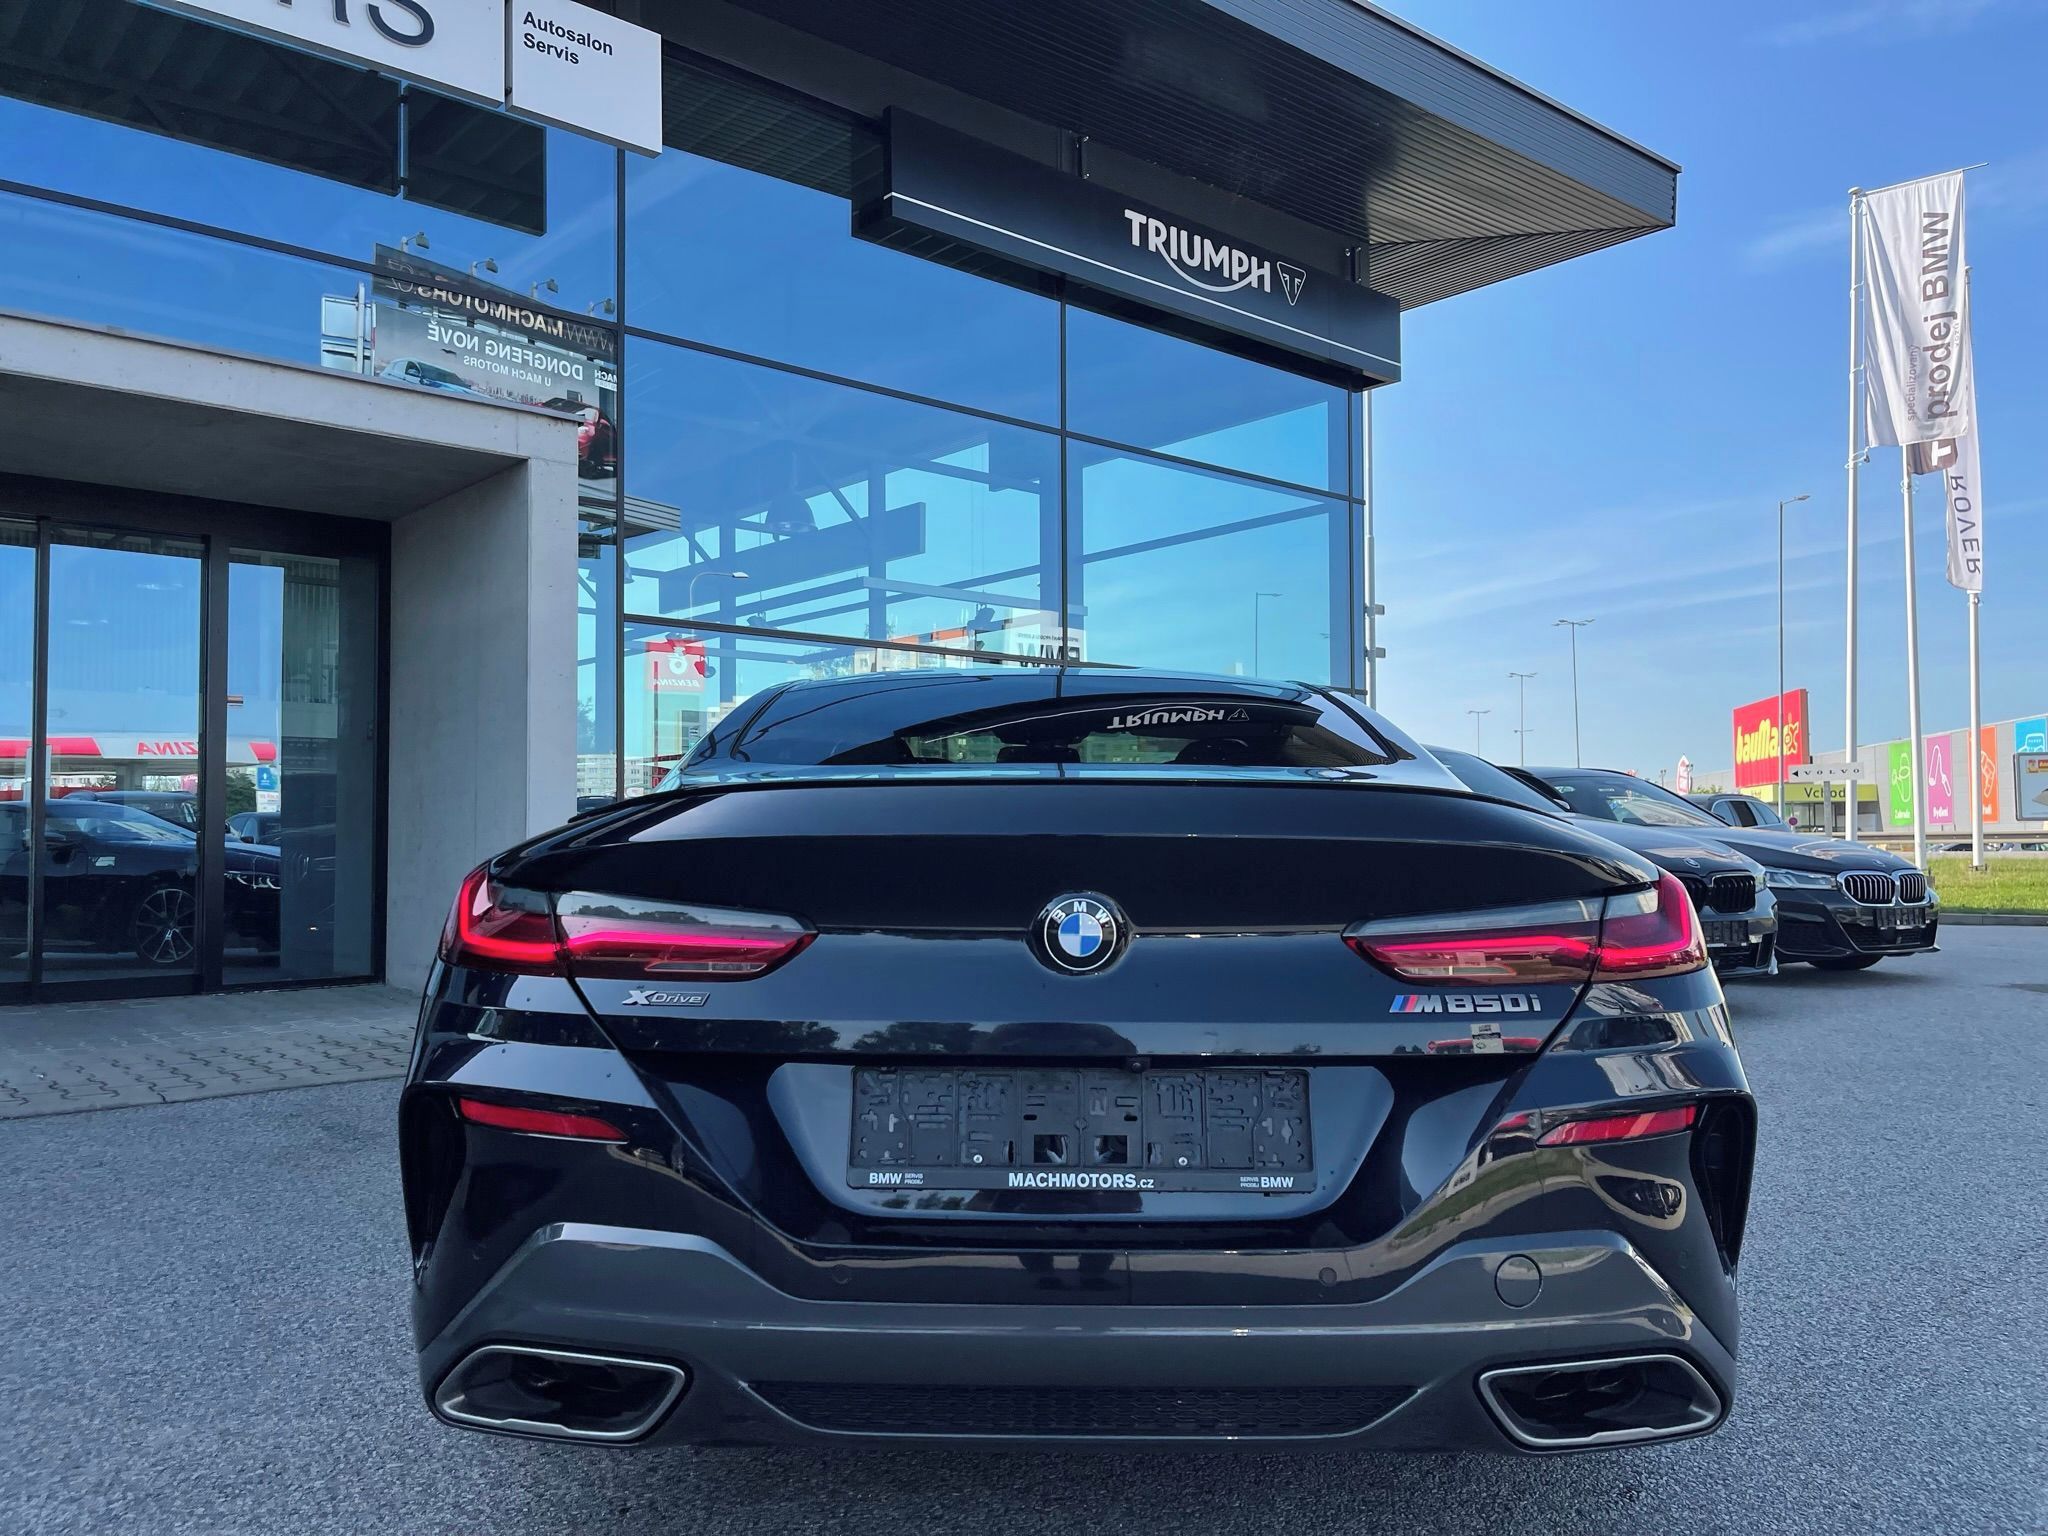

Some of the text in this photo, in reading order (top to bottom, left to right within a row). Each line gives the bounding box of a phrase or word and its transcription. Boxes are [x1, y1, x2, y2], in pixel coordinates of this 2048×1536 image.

[523, 11, 613, 56] Autosalon
[523, 32, 580, 65] Servis
[1124, 208, 1271, 294] TRIUMPH
[1922, 212, 1958, 422] prodej BMW
[1804, 768, 1860, 776] VOLVO
[1051, 901, 1110, 924] BMW
[869, 1173, 902, 1185] BMW
[1008, 1173, 1154, 1188] MACHMOTORS.cz
[1260, 1176, 1294, 1188] BMW
